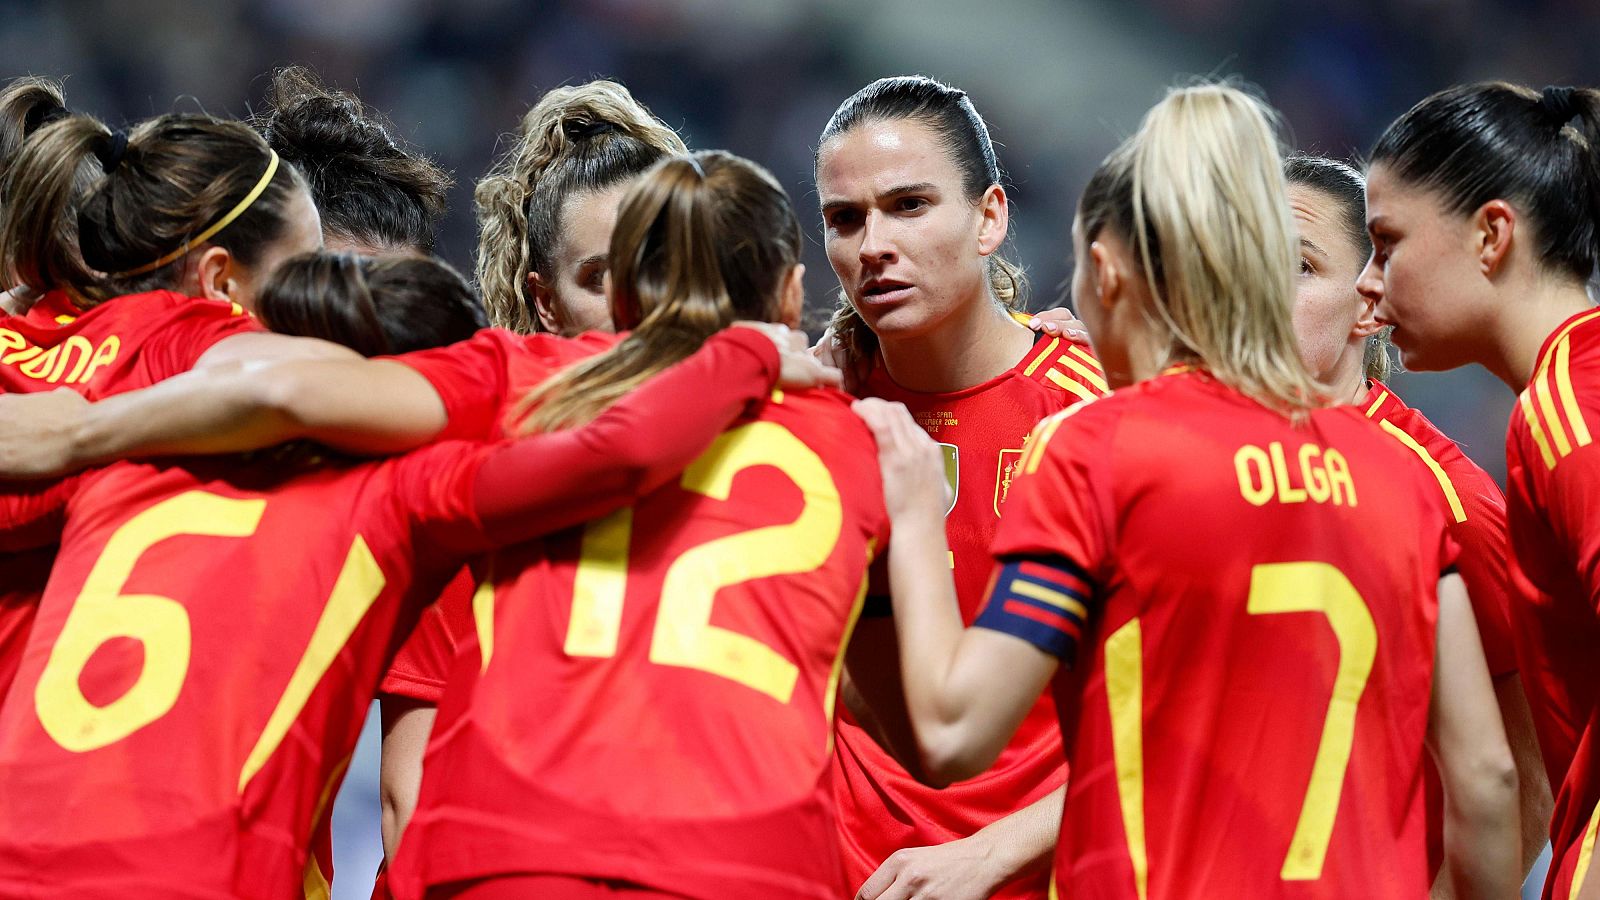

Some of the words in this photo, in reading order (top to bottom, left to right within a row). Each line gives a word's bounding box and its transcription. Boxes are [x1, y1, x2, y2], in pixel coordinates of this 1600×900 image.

[564, 421, 843, 704] 12
[1234, 441, 1358, 507] OLGA
[35, 490, 267, 752] 6
[1247, 561, 1378, 880] 7
